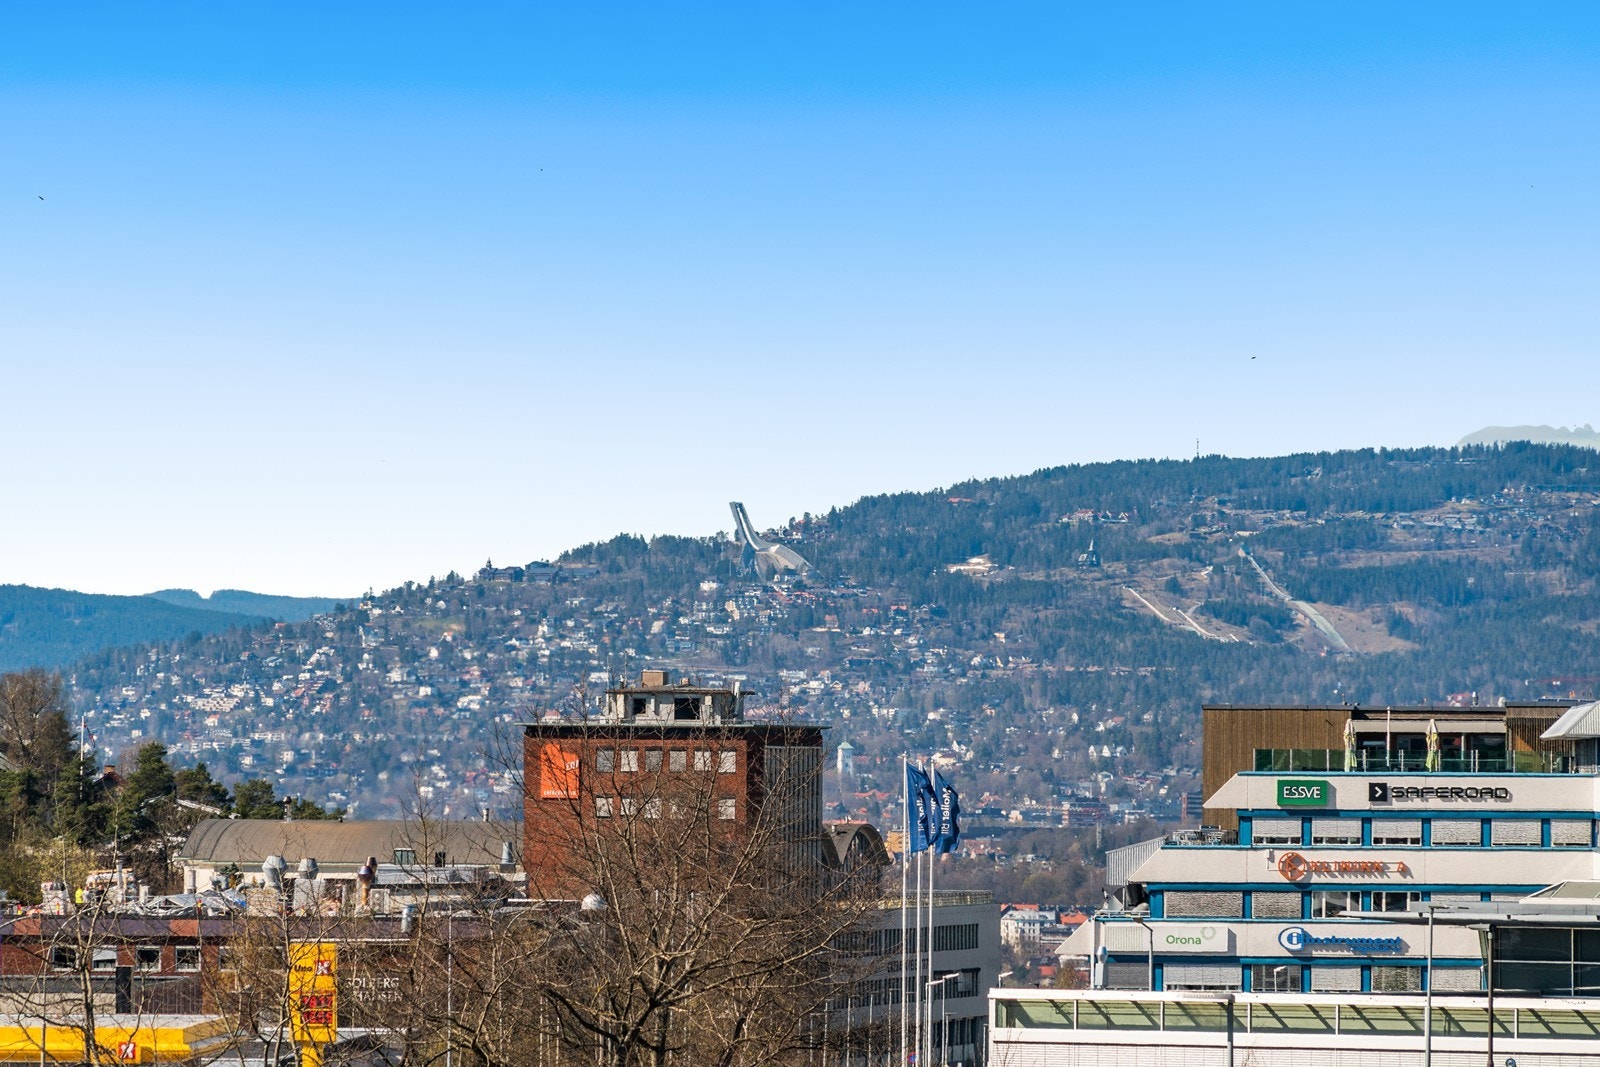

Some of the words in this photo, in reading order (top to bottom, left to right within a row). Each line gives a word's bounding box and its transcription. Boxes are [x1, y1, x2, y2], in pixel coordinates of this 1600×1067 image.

[1283, 786, 1321, 799] ESSVE
[1391, 786, 1509, 799] SAFEROAD
[1166, 934, 1202, 945] Orona
